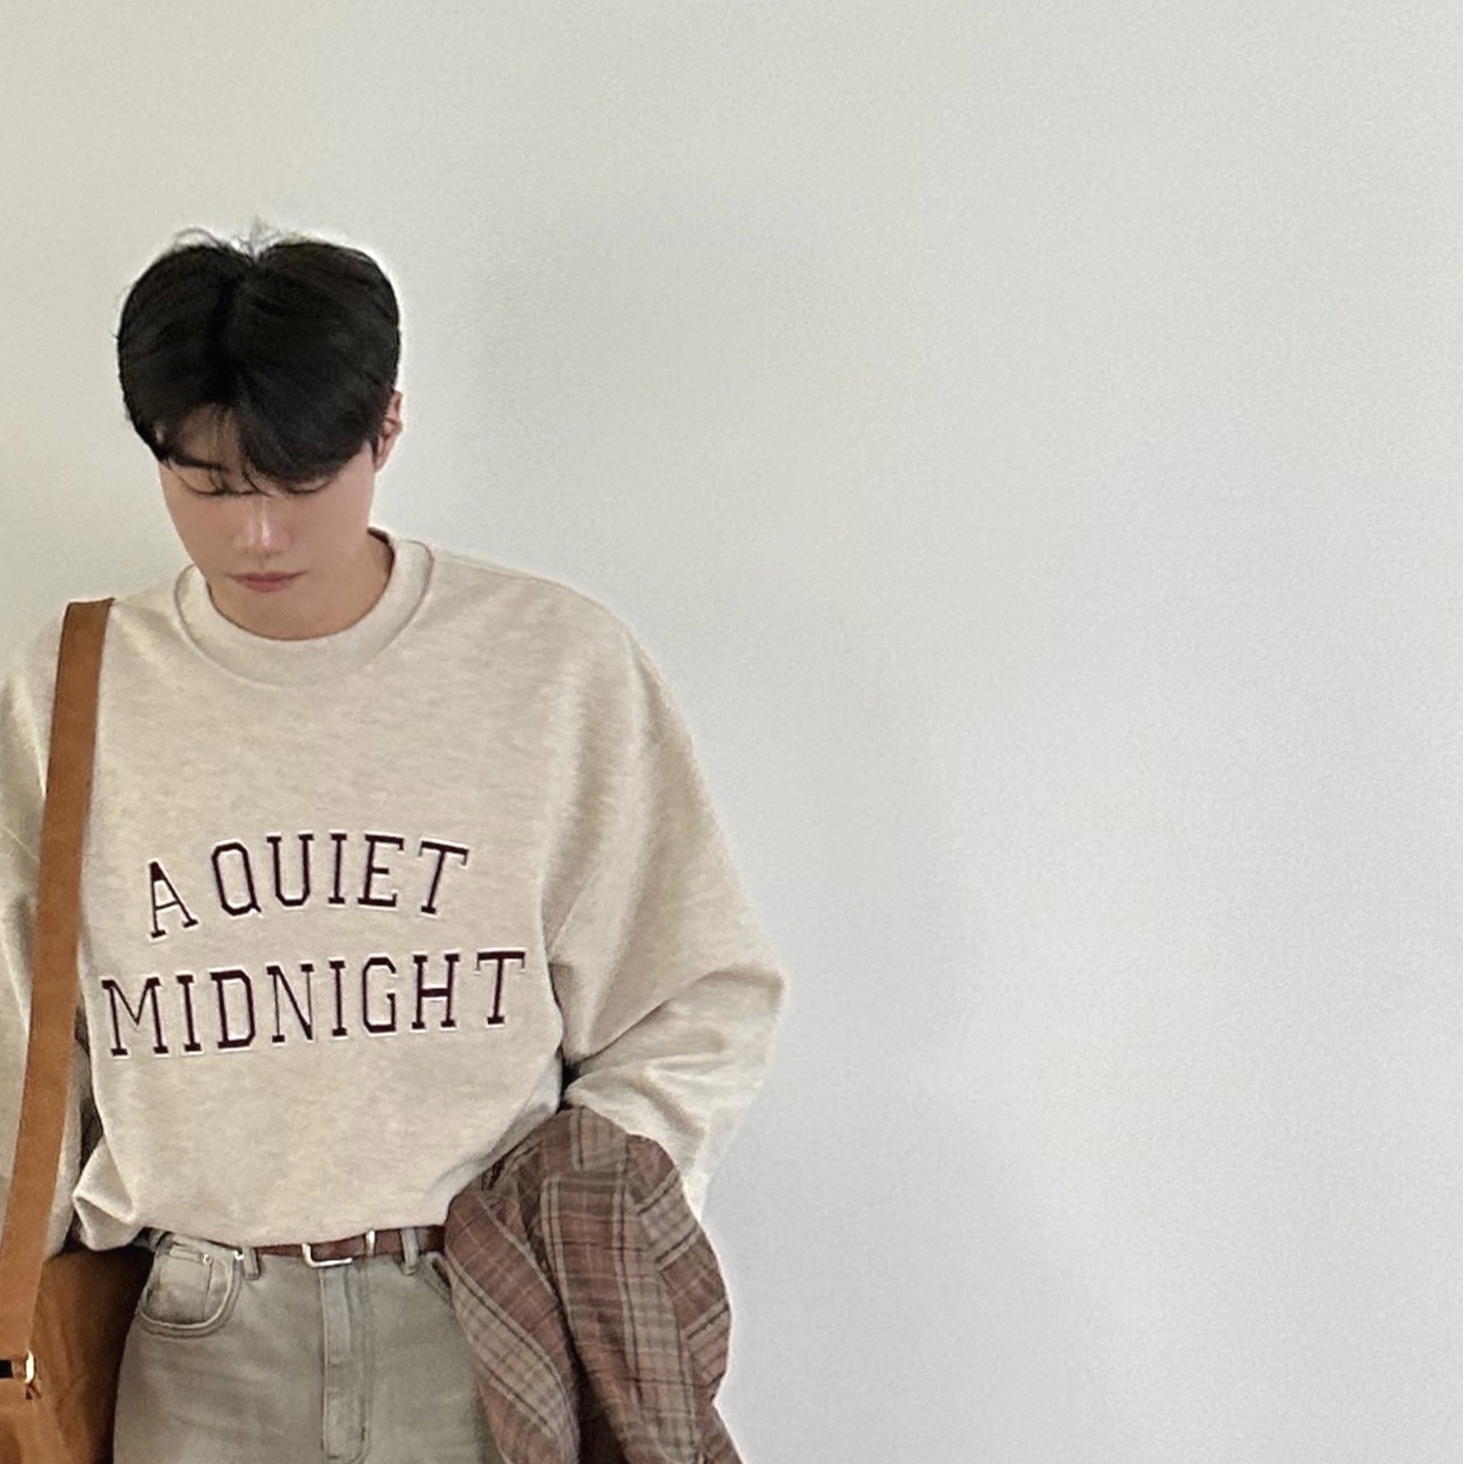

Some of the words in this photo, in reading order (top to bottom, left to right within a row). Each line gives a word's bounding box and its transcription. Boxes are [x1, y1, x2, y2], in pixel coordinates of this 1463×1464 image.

[149, 861, 198, 939] A
[210, 833, 469, 917] QUIET
[101, 951, 526, 1057] MIDNIGHT
